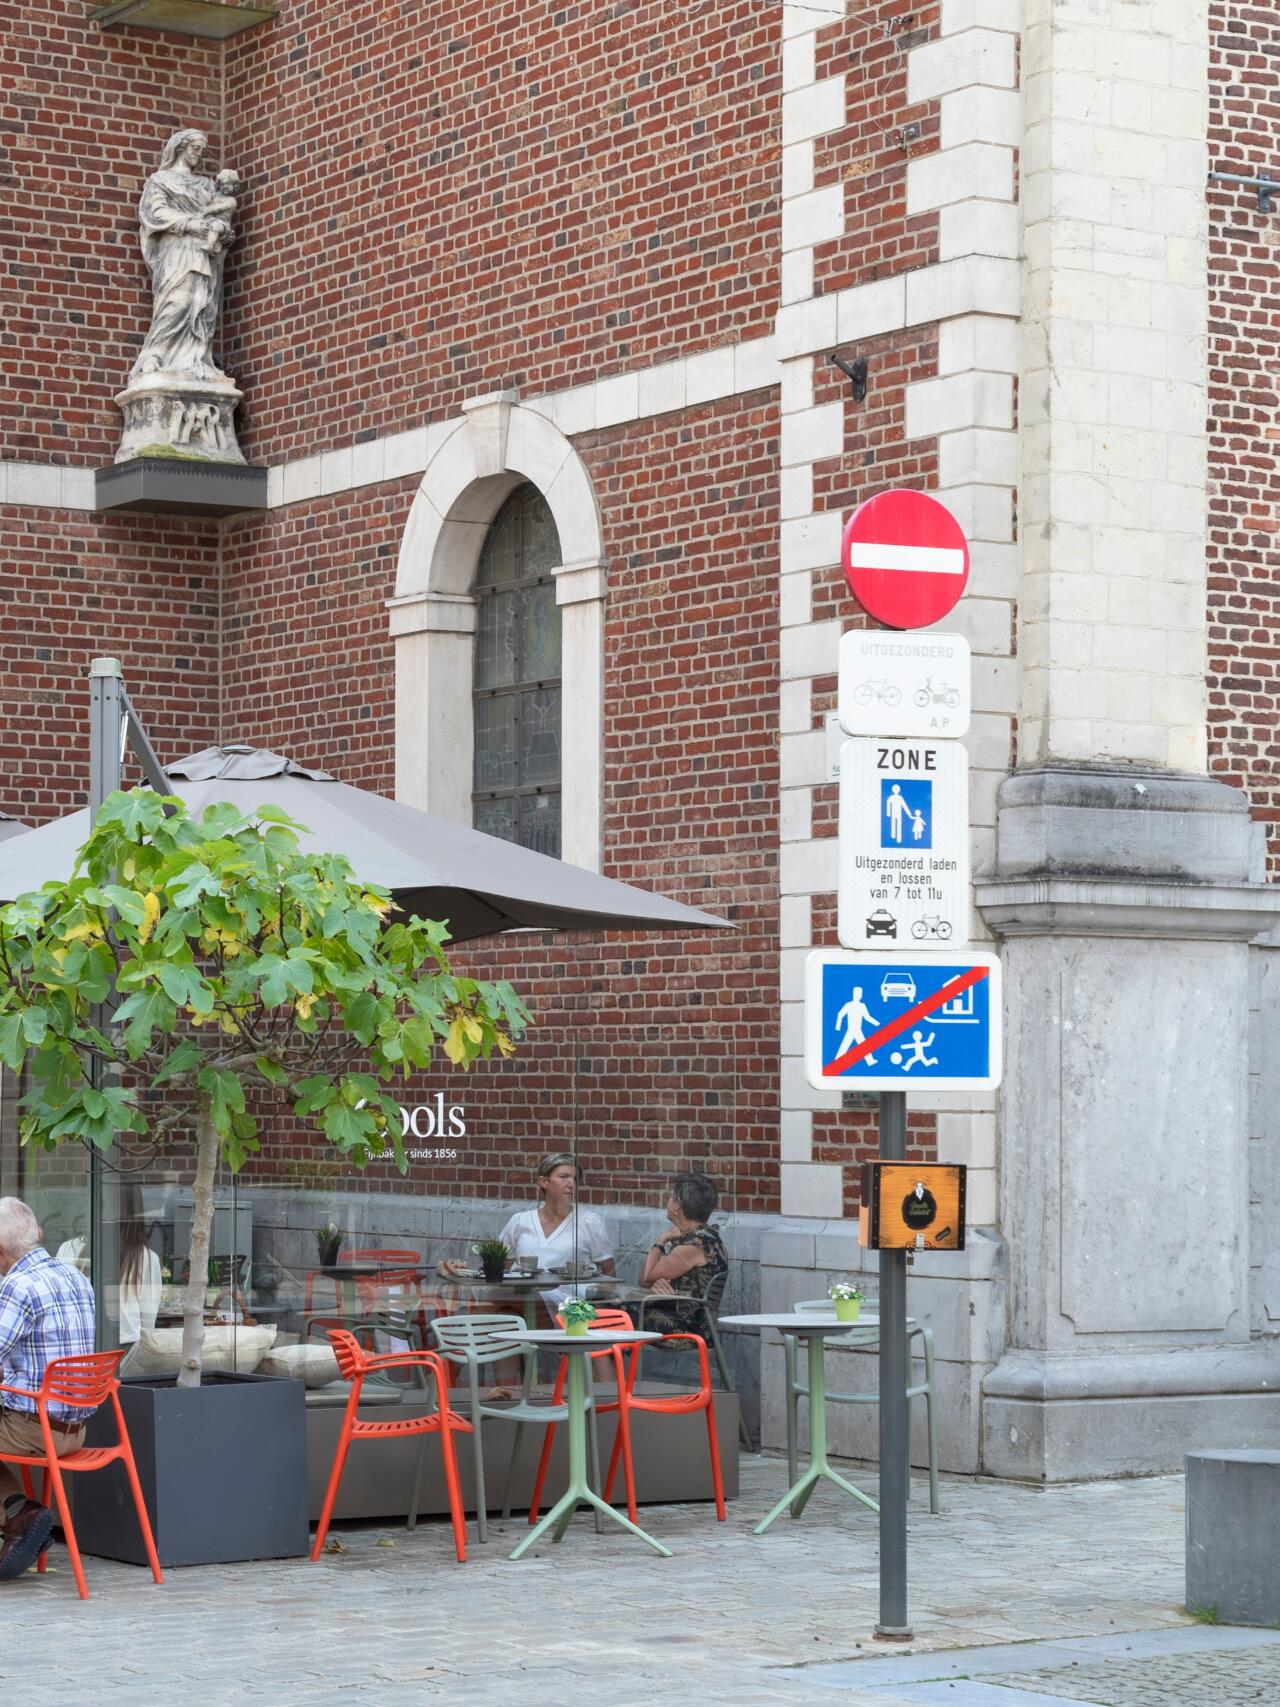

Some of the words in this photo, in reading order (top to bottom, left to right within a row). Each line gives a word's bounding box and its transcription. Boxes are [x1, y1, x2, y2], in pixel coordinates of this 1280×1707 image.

[860, 643, 954, 658] UITGEZONDERD
[877, 748, 937, 771] ZONE
[855, 855, 924, 872] Uitgezonderd
[929, 857, 957, 871] laden
[880, 874, 893, 884] en
[898, 871, 932, 885] lossen
[869, 887, 888, 899] van
[894, 886, 901, 899] 7
[907, 887, 922, 900] tot
[928, 887, 943, 900] 11u
[410, 1148, 433, 1159] sinds
[434, 1148, 457, 1159] 1856
